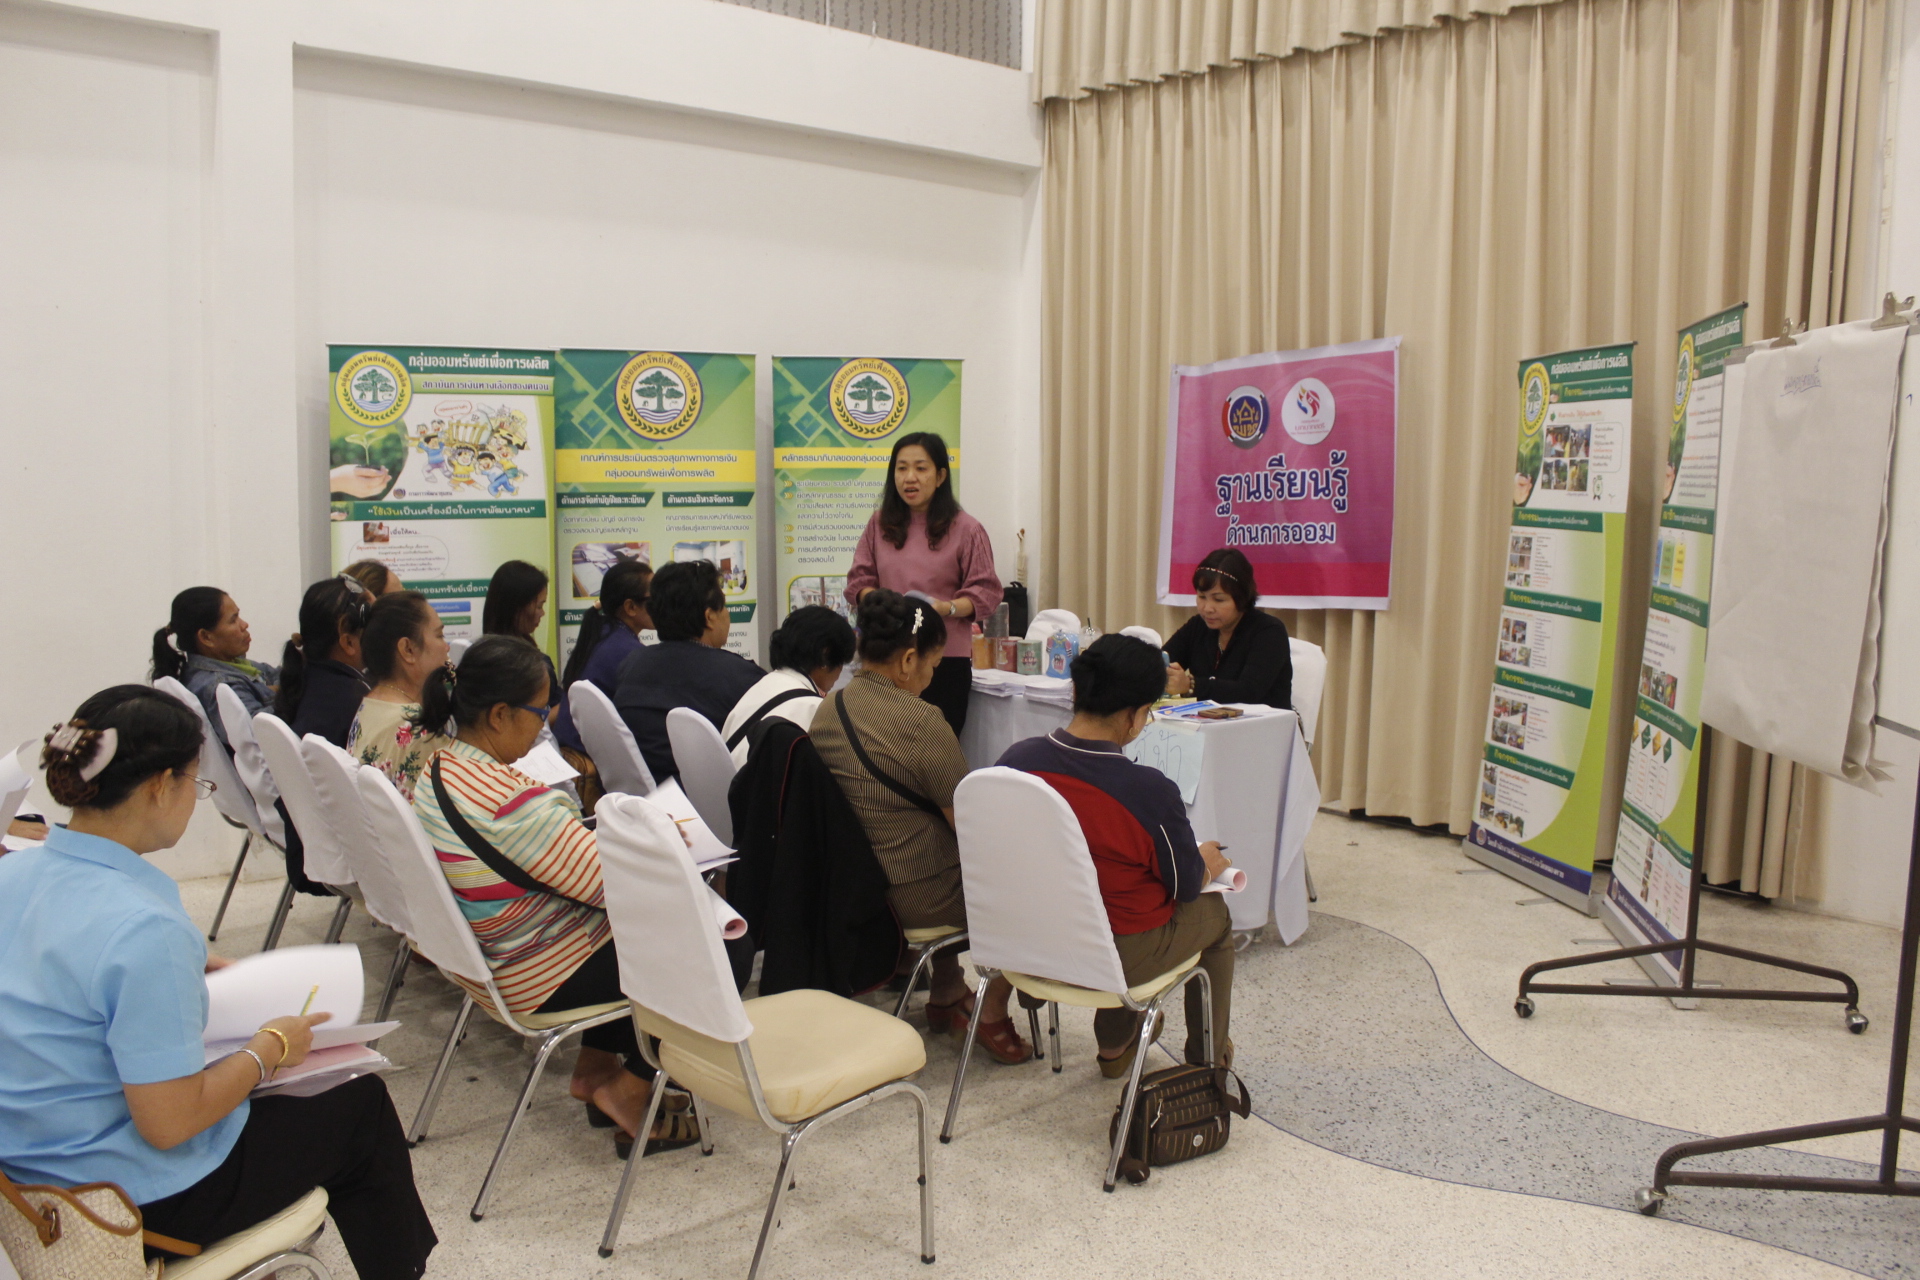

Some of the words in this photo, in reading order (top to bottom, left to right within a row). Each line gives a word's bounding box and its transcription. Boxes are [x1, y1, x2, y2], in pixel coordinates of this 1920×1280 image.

[408, 351, 549, 372] กลุ่มออมทรัพย์เพื่อการผลิต
[604, 467, 715, 480] กลุ่มออมทรัพย์เพื่อการผลิต
[1216, 450, 1350, 517] ฐานเรียนรู้
[1226, 515, 1337, 545] ด้านการออม
